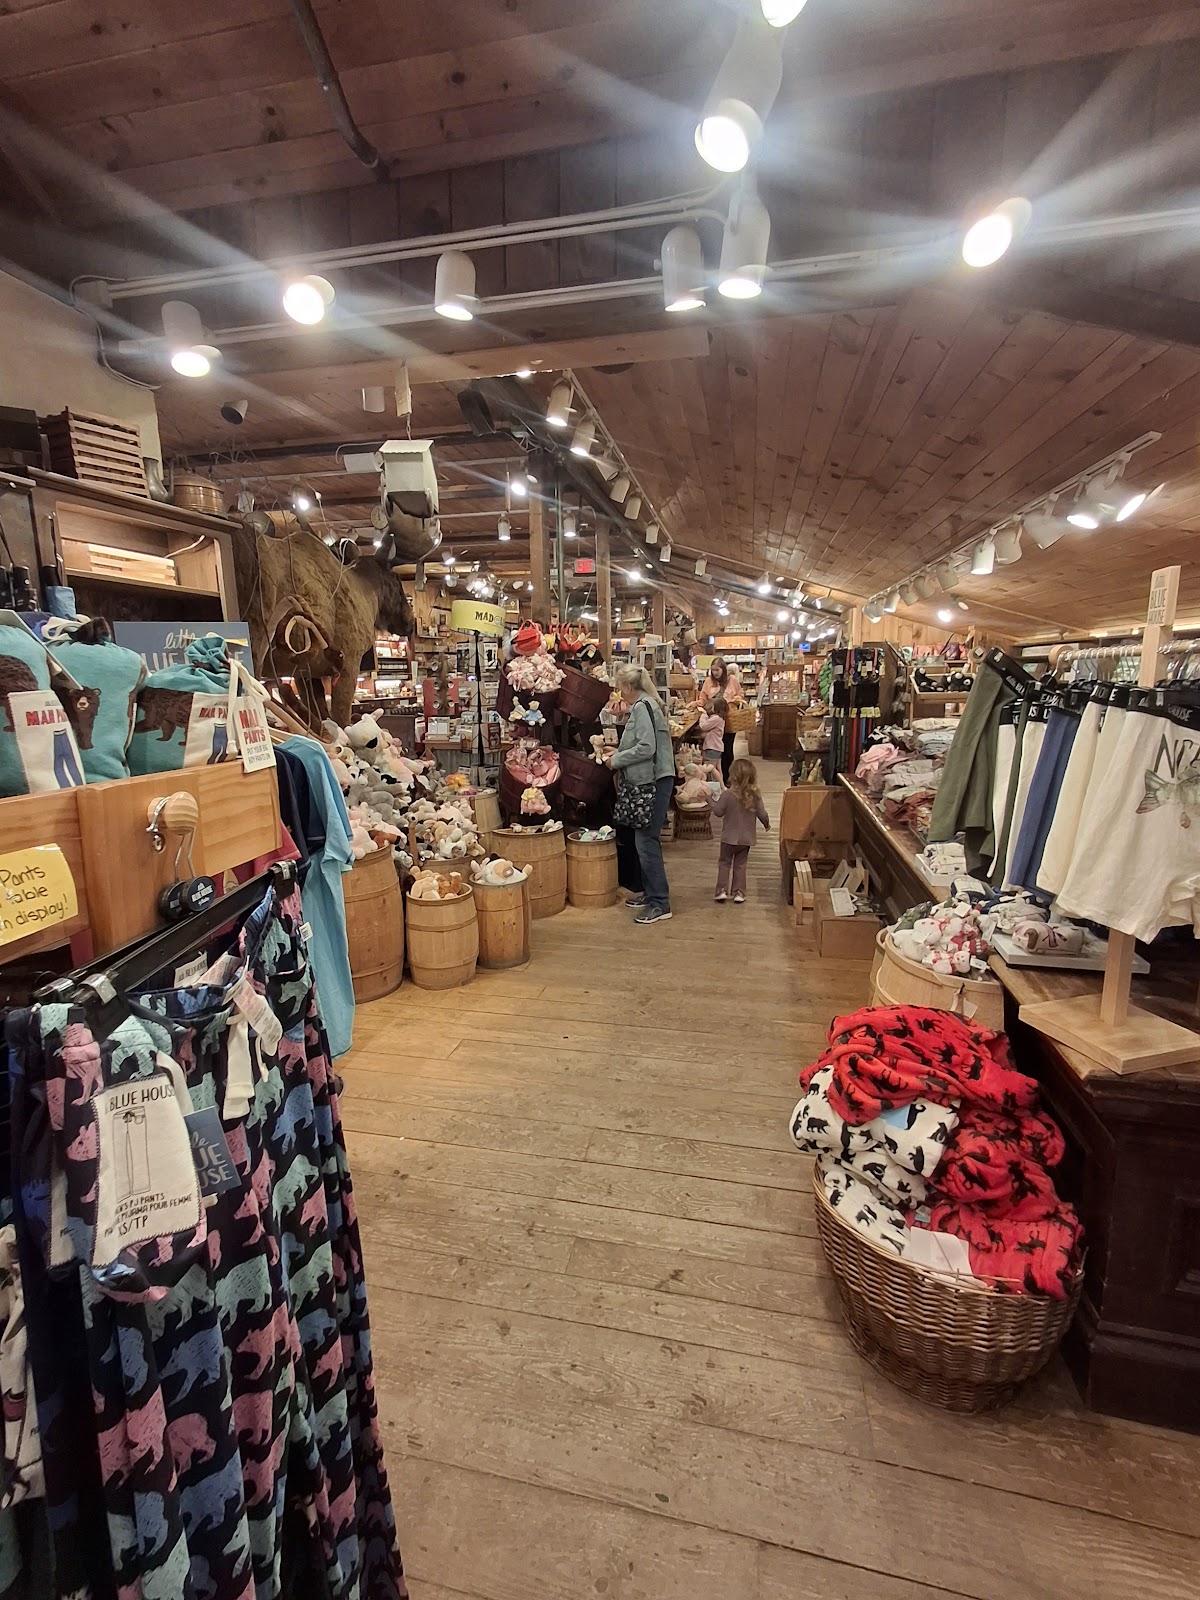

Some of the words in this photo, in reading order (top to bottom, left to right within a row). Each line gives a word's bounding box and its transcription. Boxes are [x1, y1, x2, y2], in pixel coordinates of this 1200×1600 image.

[243, 728, 266, 744] PANTS
[0, 866, 46, 887] Pants
[15, 893, 69, 925] display!
[109, 1091, 138, 1112] BLUE
[141, 1084, 175, 1103] HOUS
[140, 1193, 165, 1205] PANTS
[149, 1200, 168, 1212] POUR
[169, 1193, 193, 1207] FEMME
